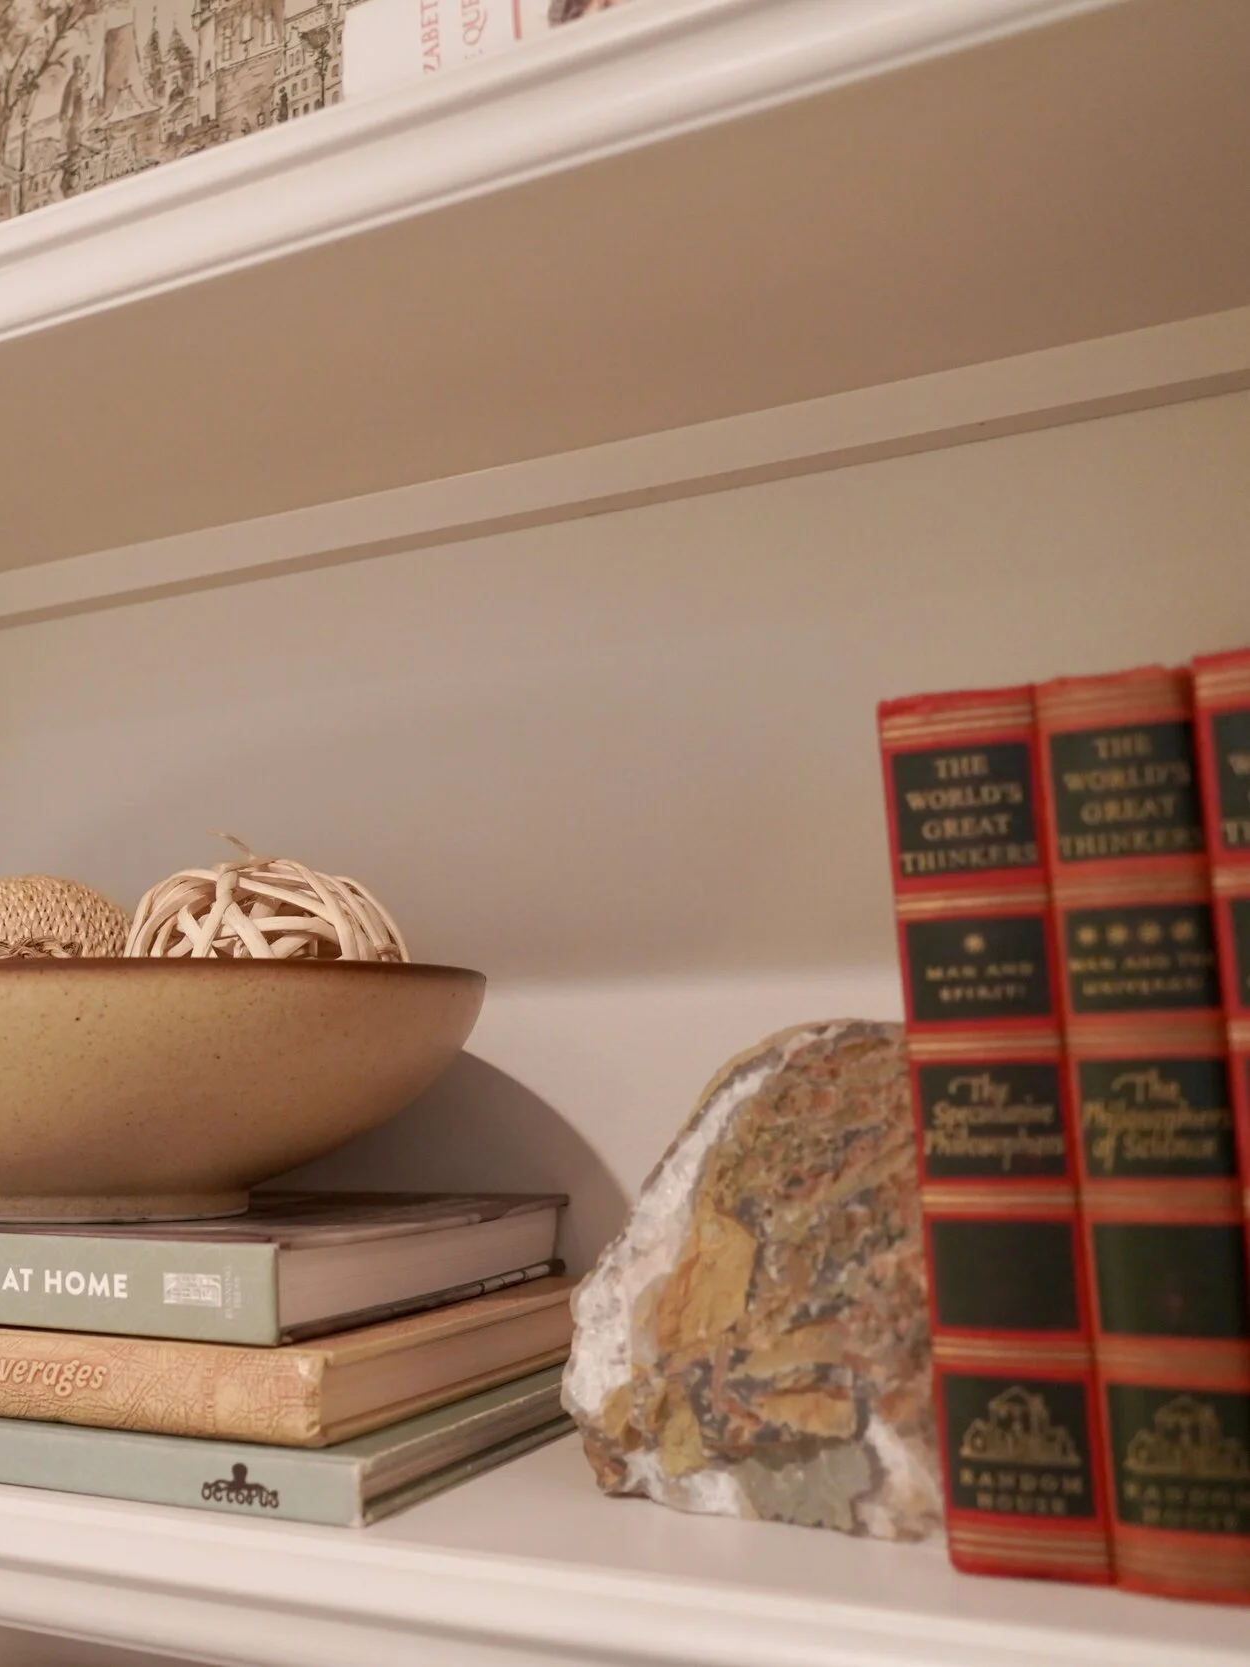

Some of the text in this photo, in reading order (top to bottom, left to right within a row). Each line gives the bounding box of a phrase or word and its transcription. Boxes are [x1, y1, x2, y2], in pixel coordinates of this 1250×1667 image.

[1096, 735, 1152, 760] THE
[933, 754, 989, 780] THE
[1063, 762, 1188, 792] WORLD'S
[906, 782, 1024, 812] WORLD'S
[1080, 796, 1176, 825] GREAT
[921, 813, 1012, 841] GREAT
[902, 843, 1040, 875] THINKERS
[1, 1267, 33, 1293] AT
[44, 1269, 129, 1299] HOME
[959, 1467, 1083, 1495] RANDOM
